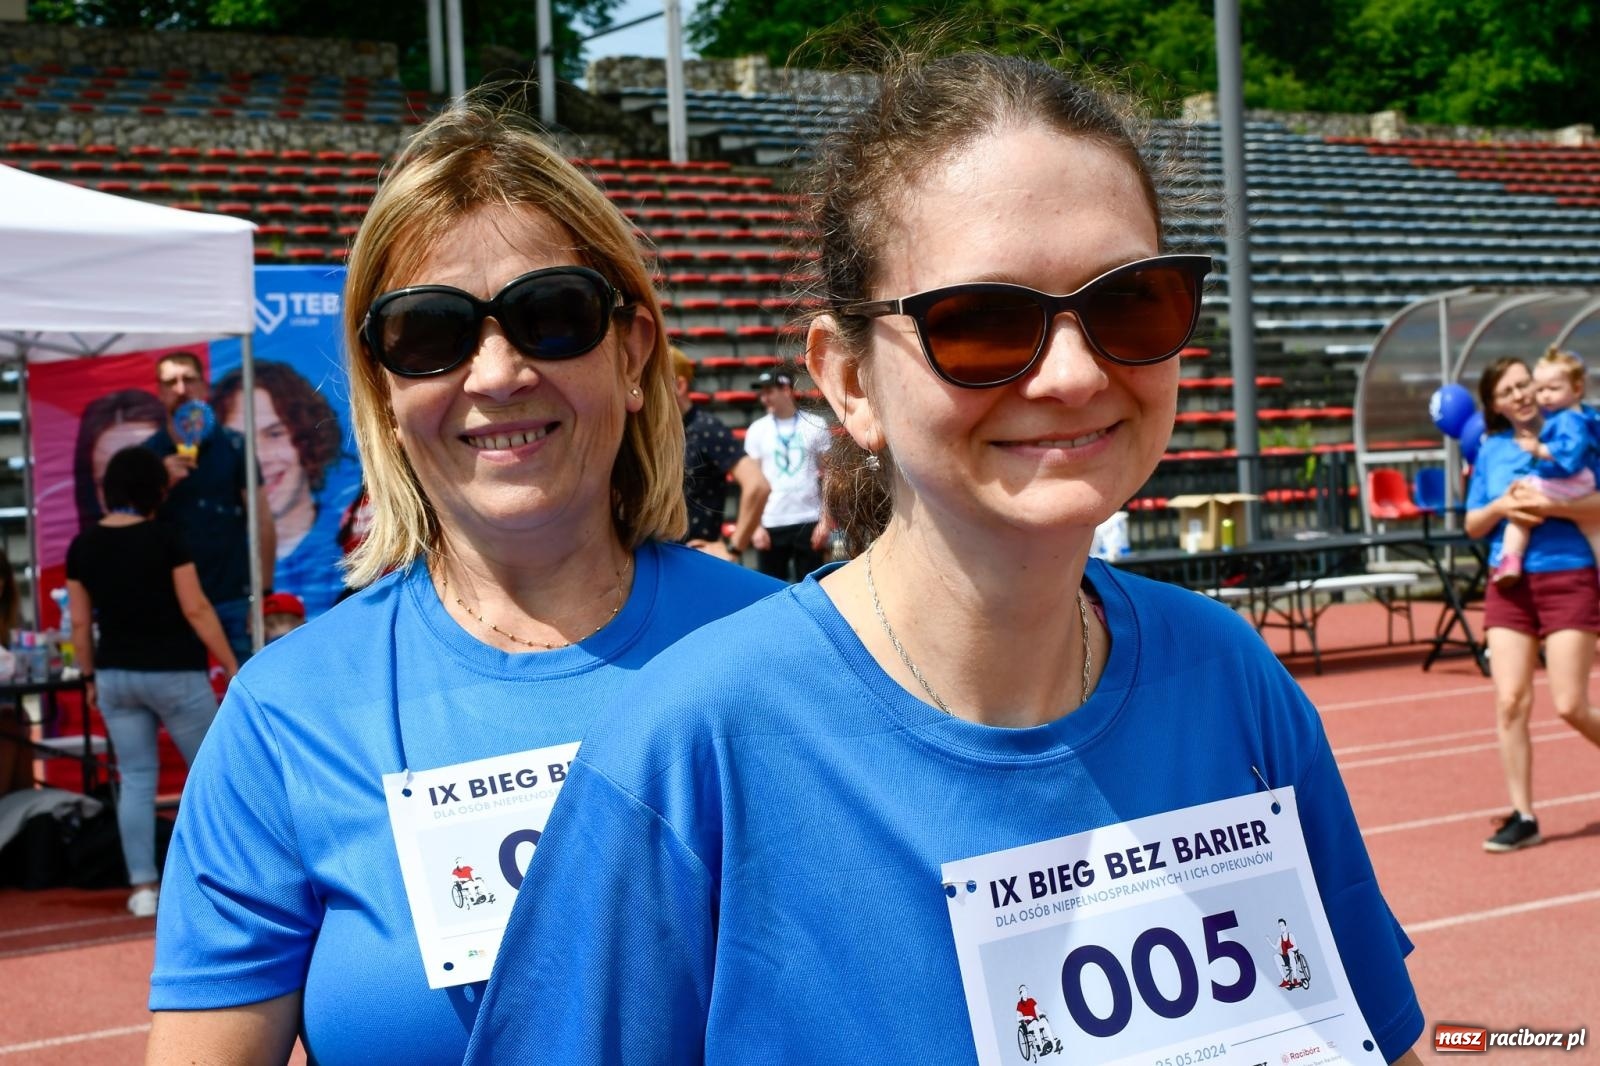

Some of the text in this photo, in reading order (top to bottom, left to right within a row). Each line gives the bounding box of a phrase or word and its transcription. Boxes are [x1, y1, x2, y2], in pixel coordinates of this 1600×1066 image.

[429, 761, 571, 806] IX BIEG B
[989, 820, 1271, 908] IX BIEG BEZ BARIER
[995, 913, 1018, 927] DLA
[1019, 902, 1050, 921] OSÓB
[1184, 870, 1189, 881] I
[1190, 865, 1209, 879] ICH
[1211, 851, 1273, 874] OPIEKUNÓW
[1061, 910, 1257, 1038] 005
